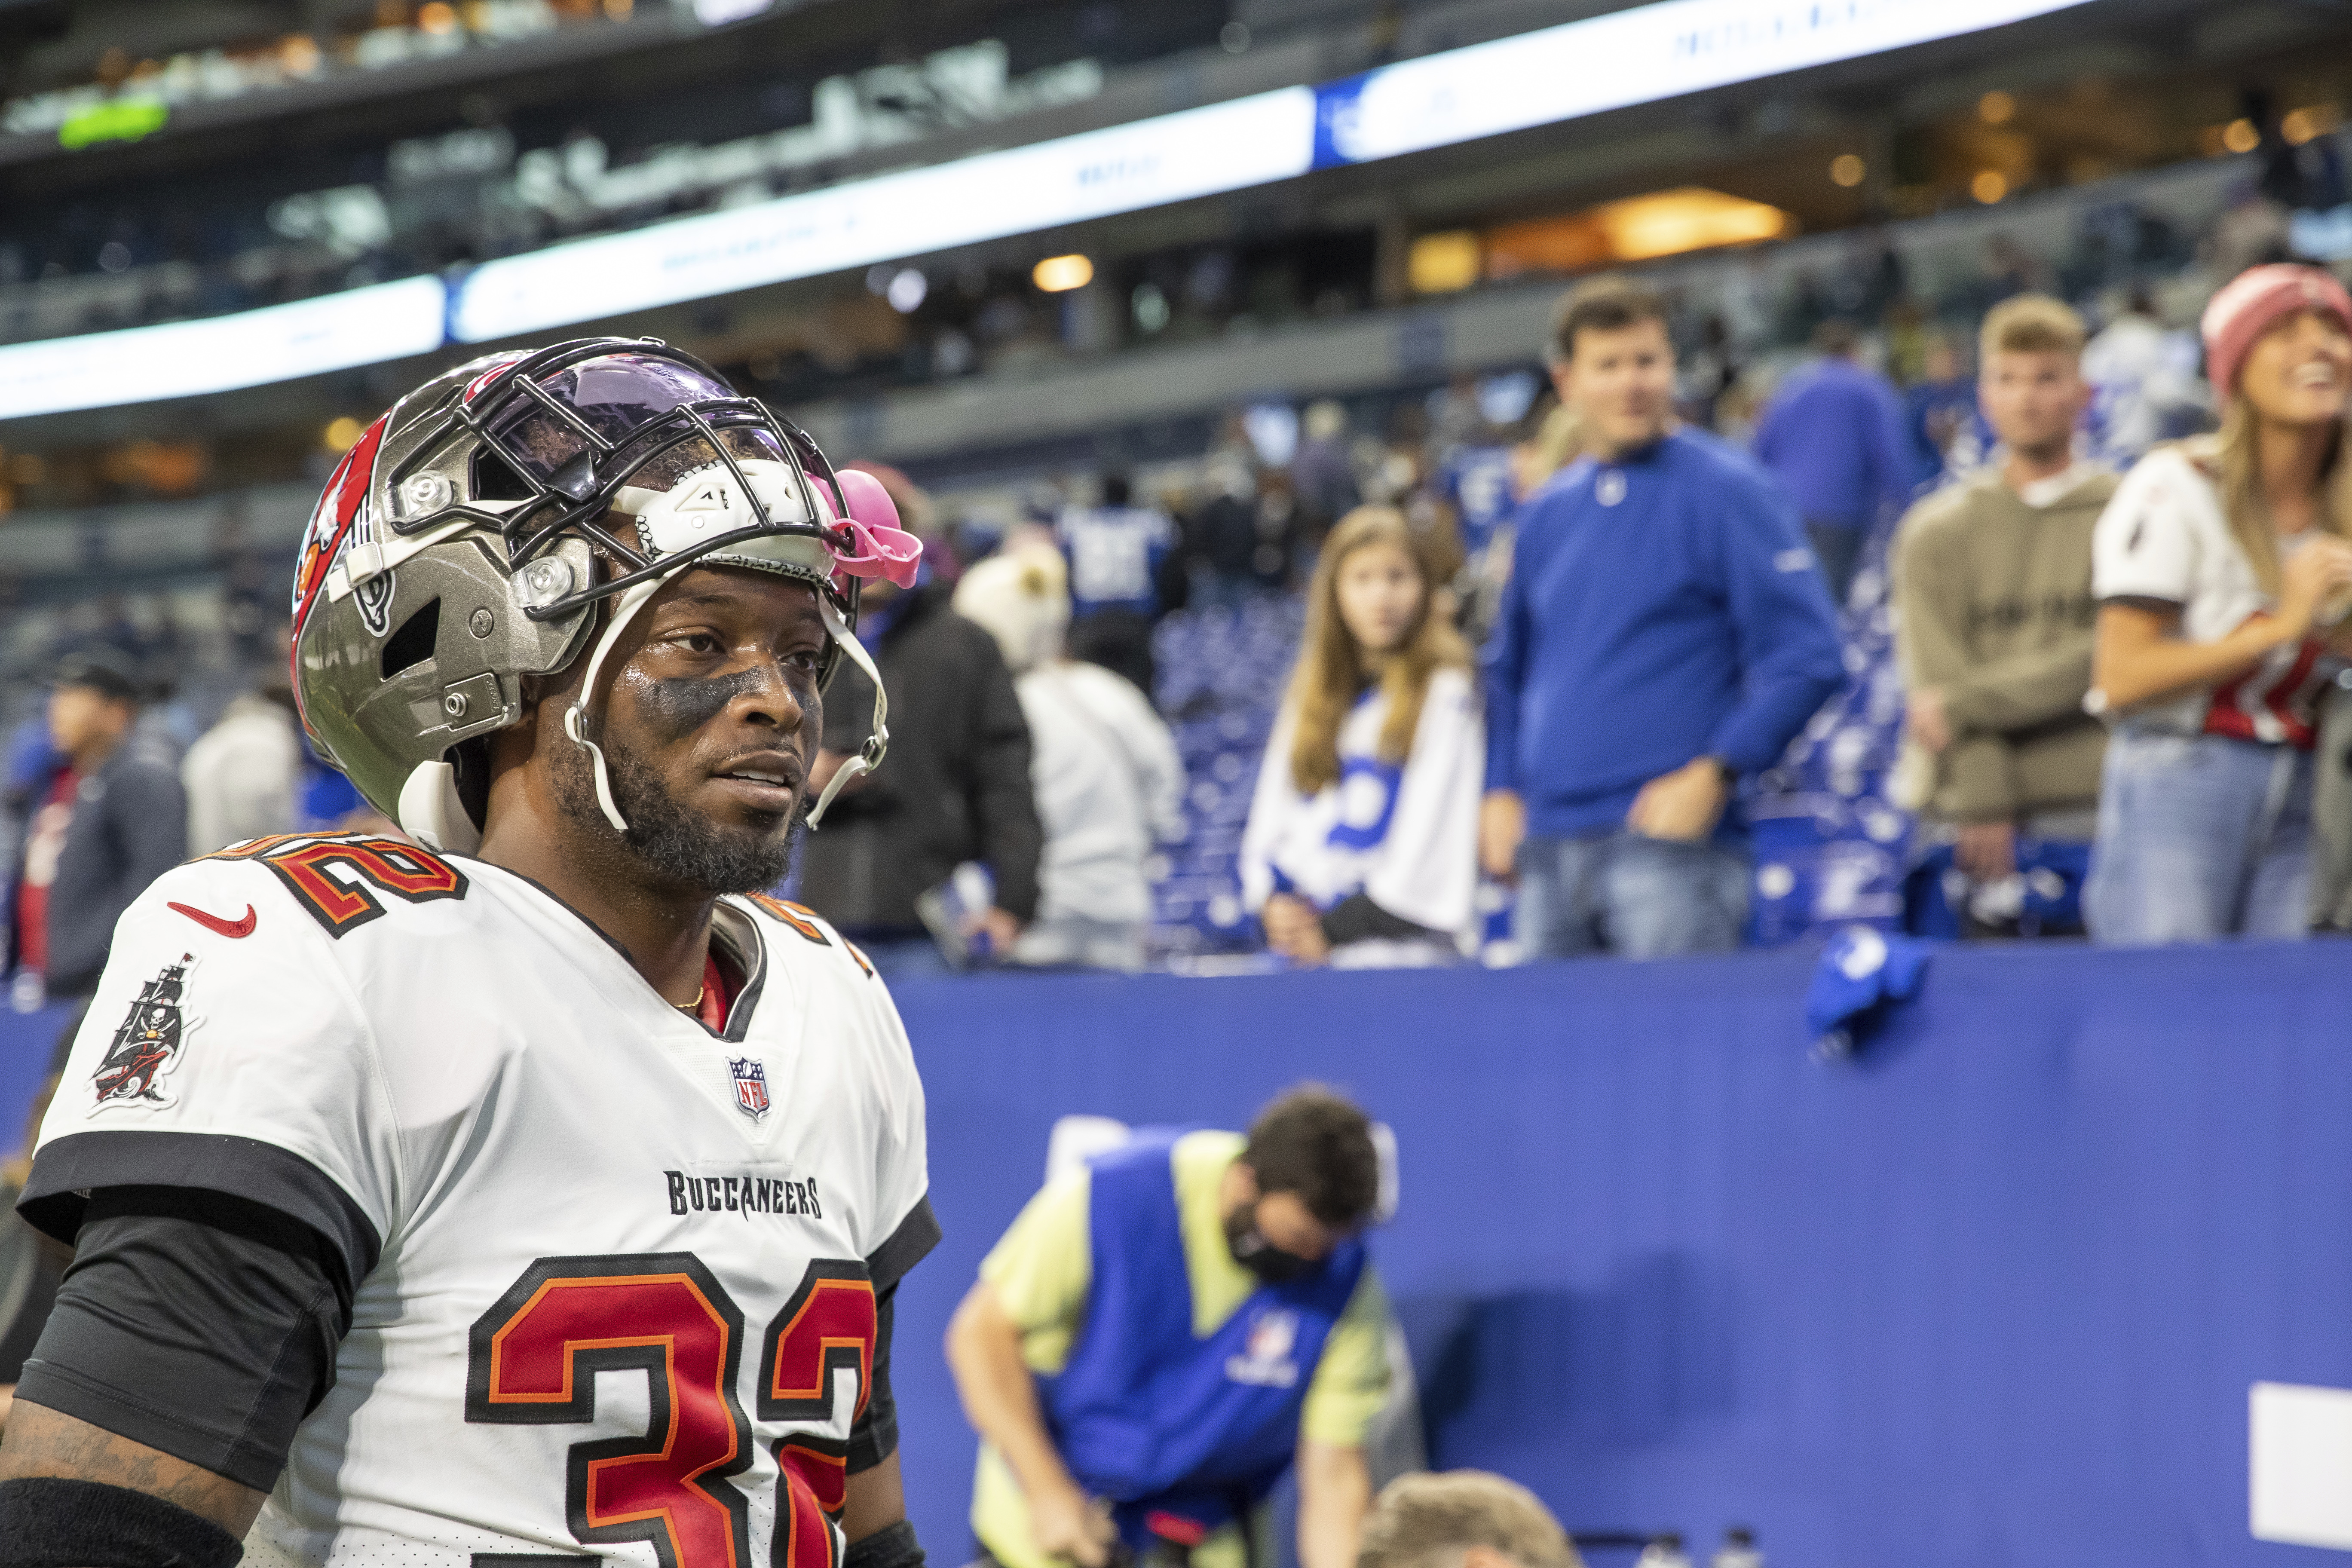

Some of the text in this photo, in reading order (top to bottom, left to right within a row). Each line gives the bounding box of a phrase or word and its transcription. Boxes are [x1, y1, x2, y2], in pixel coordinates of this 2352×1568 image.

[738, 1081, 768, 1109] NFL
[663, 1170, 822, 1222] BUCCANEERS
[464, 1251, 877, 1568] 32
